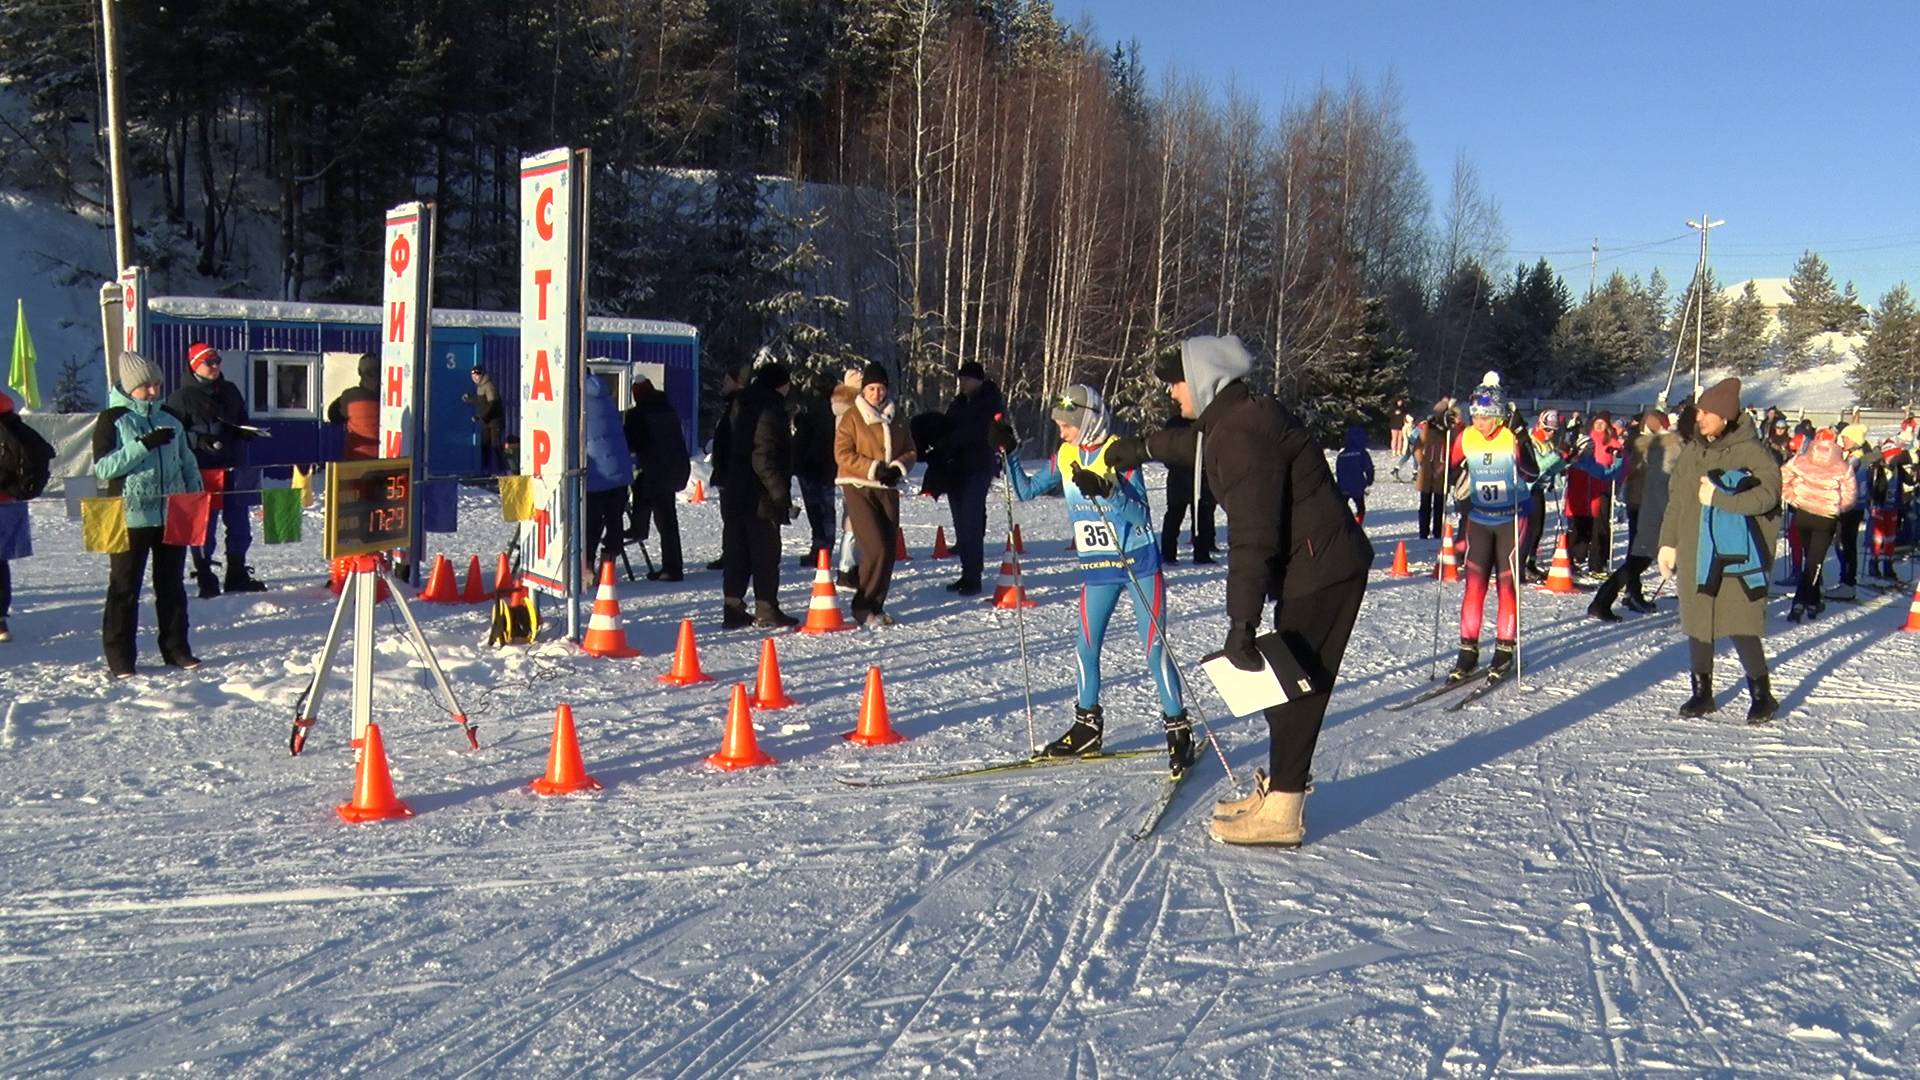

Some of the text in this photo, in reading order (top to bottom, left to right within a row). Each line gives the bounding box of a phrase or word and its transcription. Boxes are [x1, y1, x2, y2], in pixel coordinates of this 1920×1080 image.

[385, 233, 411, 459] ФИНИ
[446, 352, 456, 369] 3
[531, 186, 555, 561] СТАРТ
[386, 476, 405, 500] 35
[1083, 524, 1110, 547] 35
